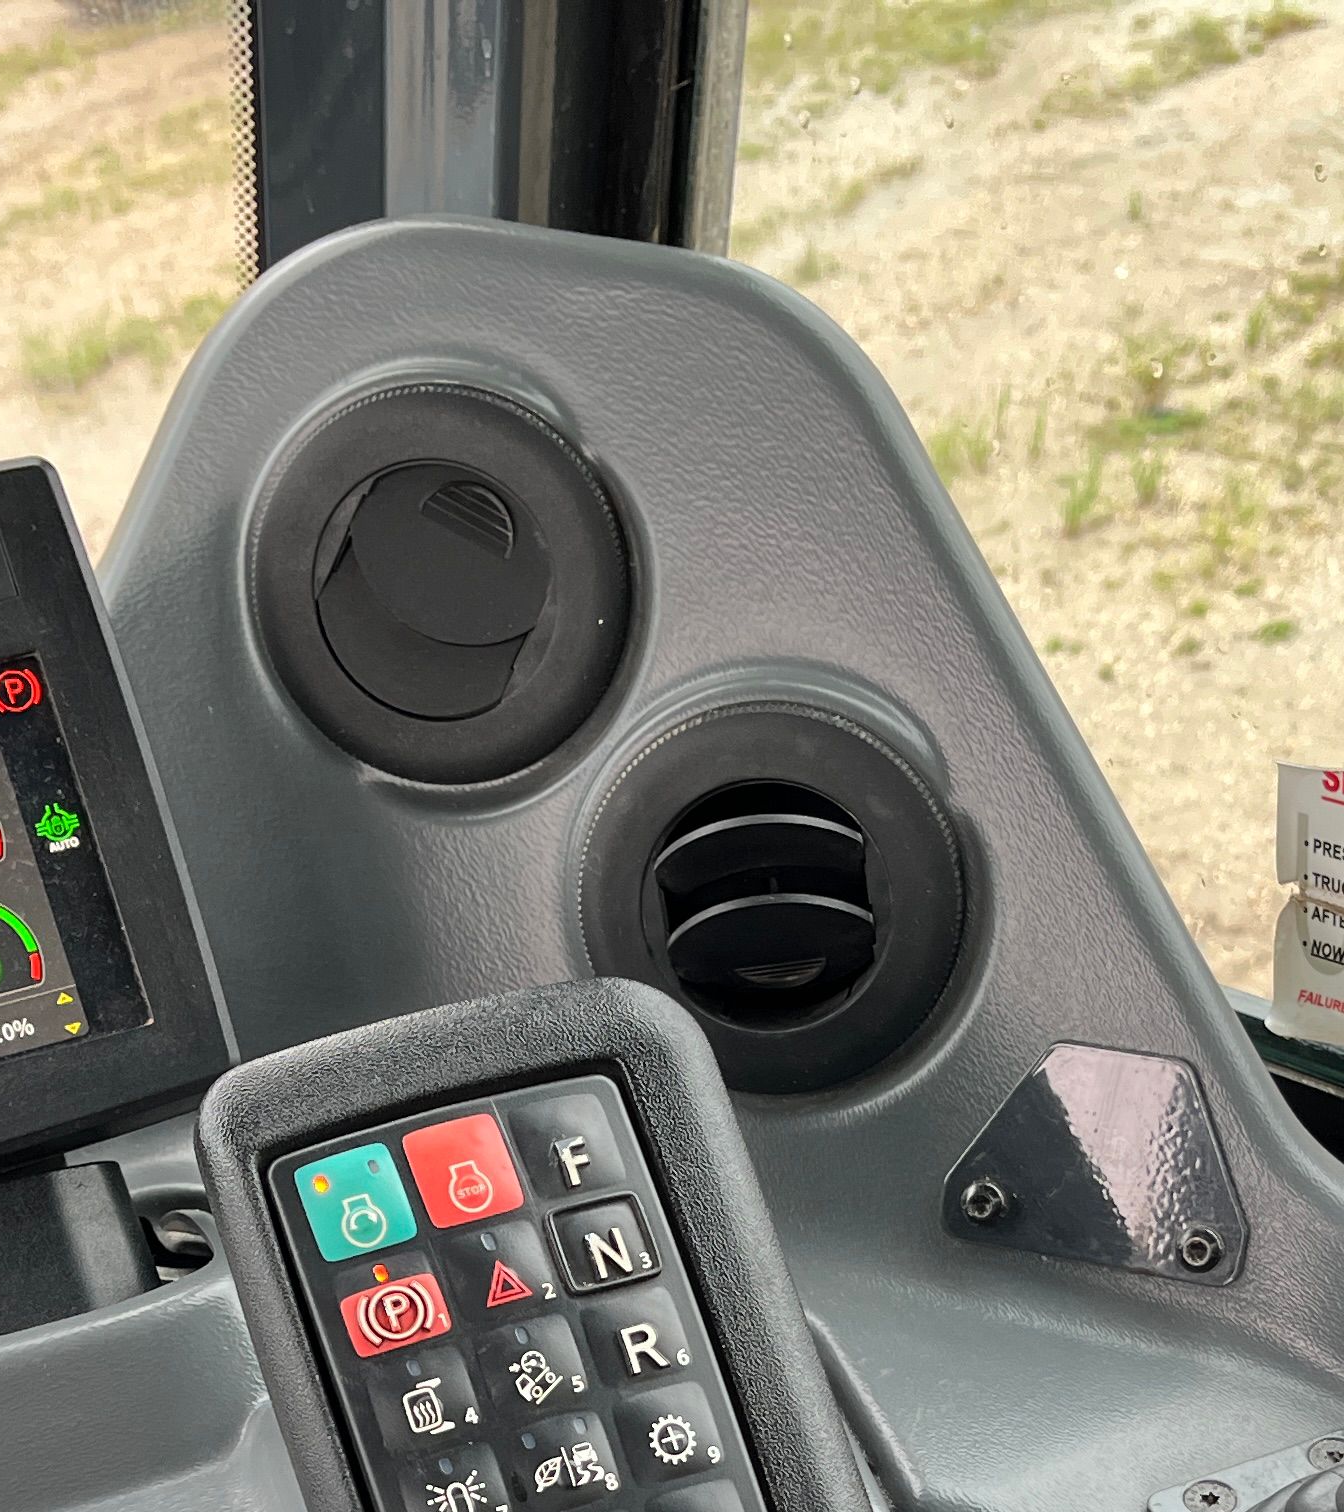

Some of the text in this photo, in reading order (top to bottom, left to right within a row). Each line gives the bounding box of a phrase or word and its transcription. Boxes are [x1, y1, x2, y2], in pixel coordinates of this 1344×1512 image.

[5, 678, 24, 705] P
[49, 836, 80, 853] AUTO
[555, 1135, 591, 1189] F
[456, 1183, 486, 1200] STOP
[583, 1227, 653, 1281] N 3
[541, 1282, 557, 1300] 2
[382, 1293, 450, 1334] P 1
[619, 1322, 691, 1376] R 6
[571, 1374, 586, 1393] 5
[464, 1406, 479, 1424] 4
[706, 1445, 721, 1464] 9
[604, 1472, 619, 1491] 8
